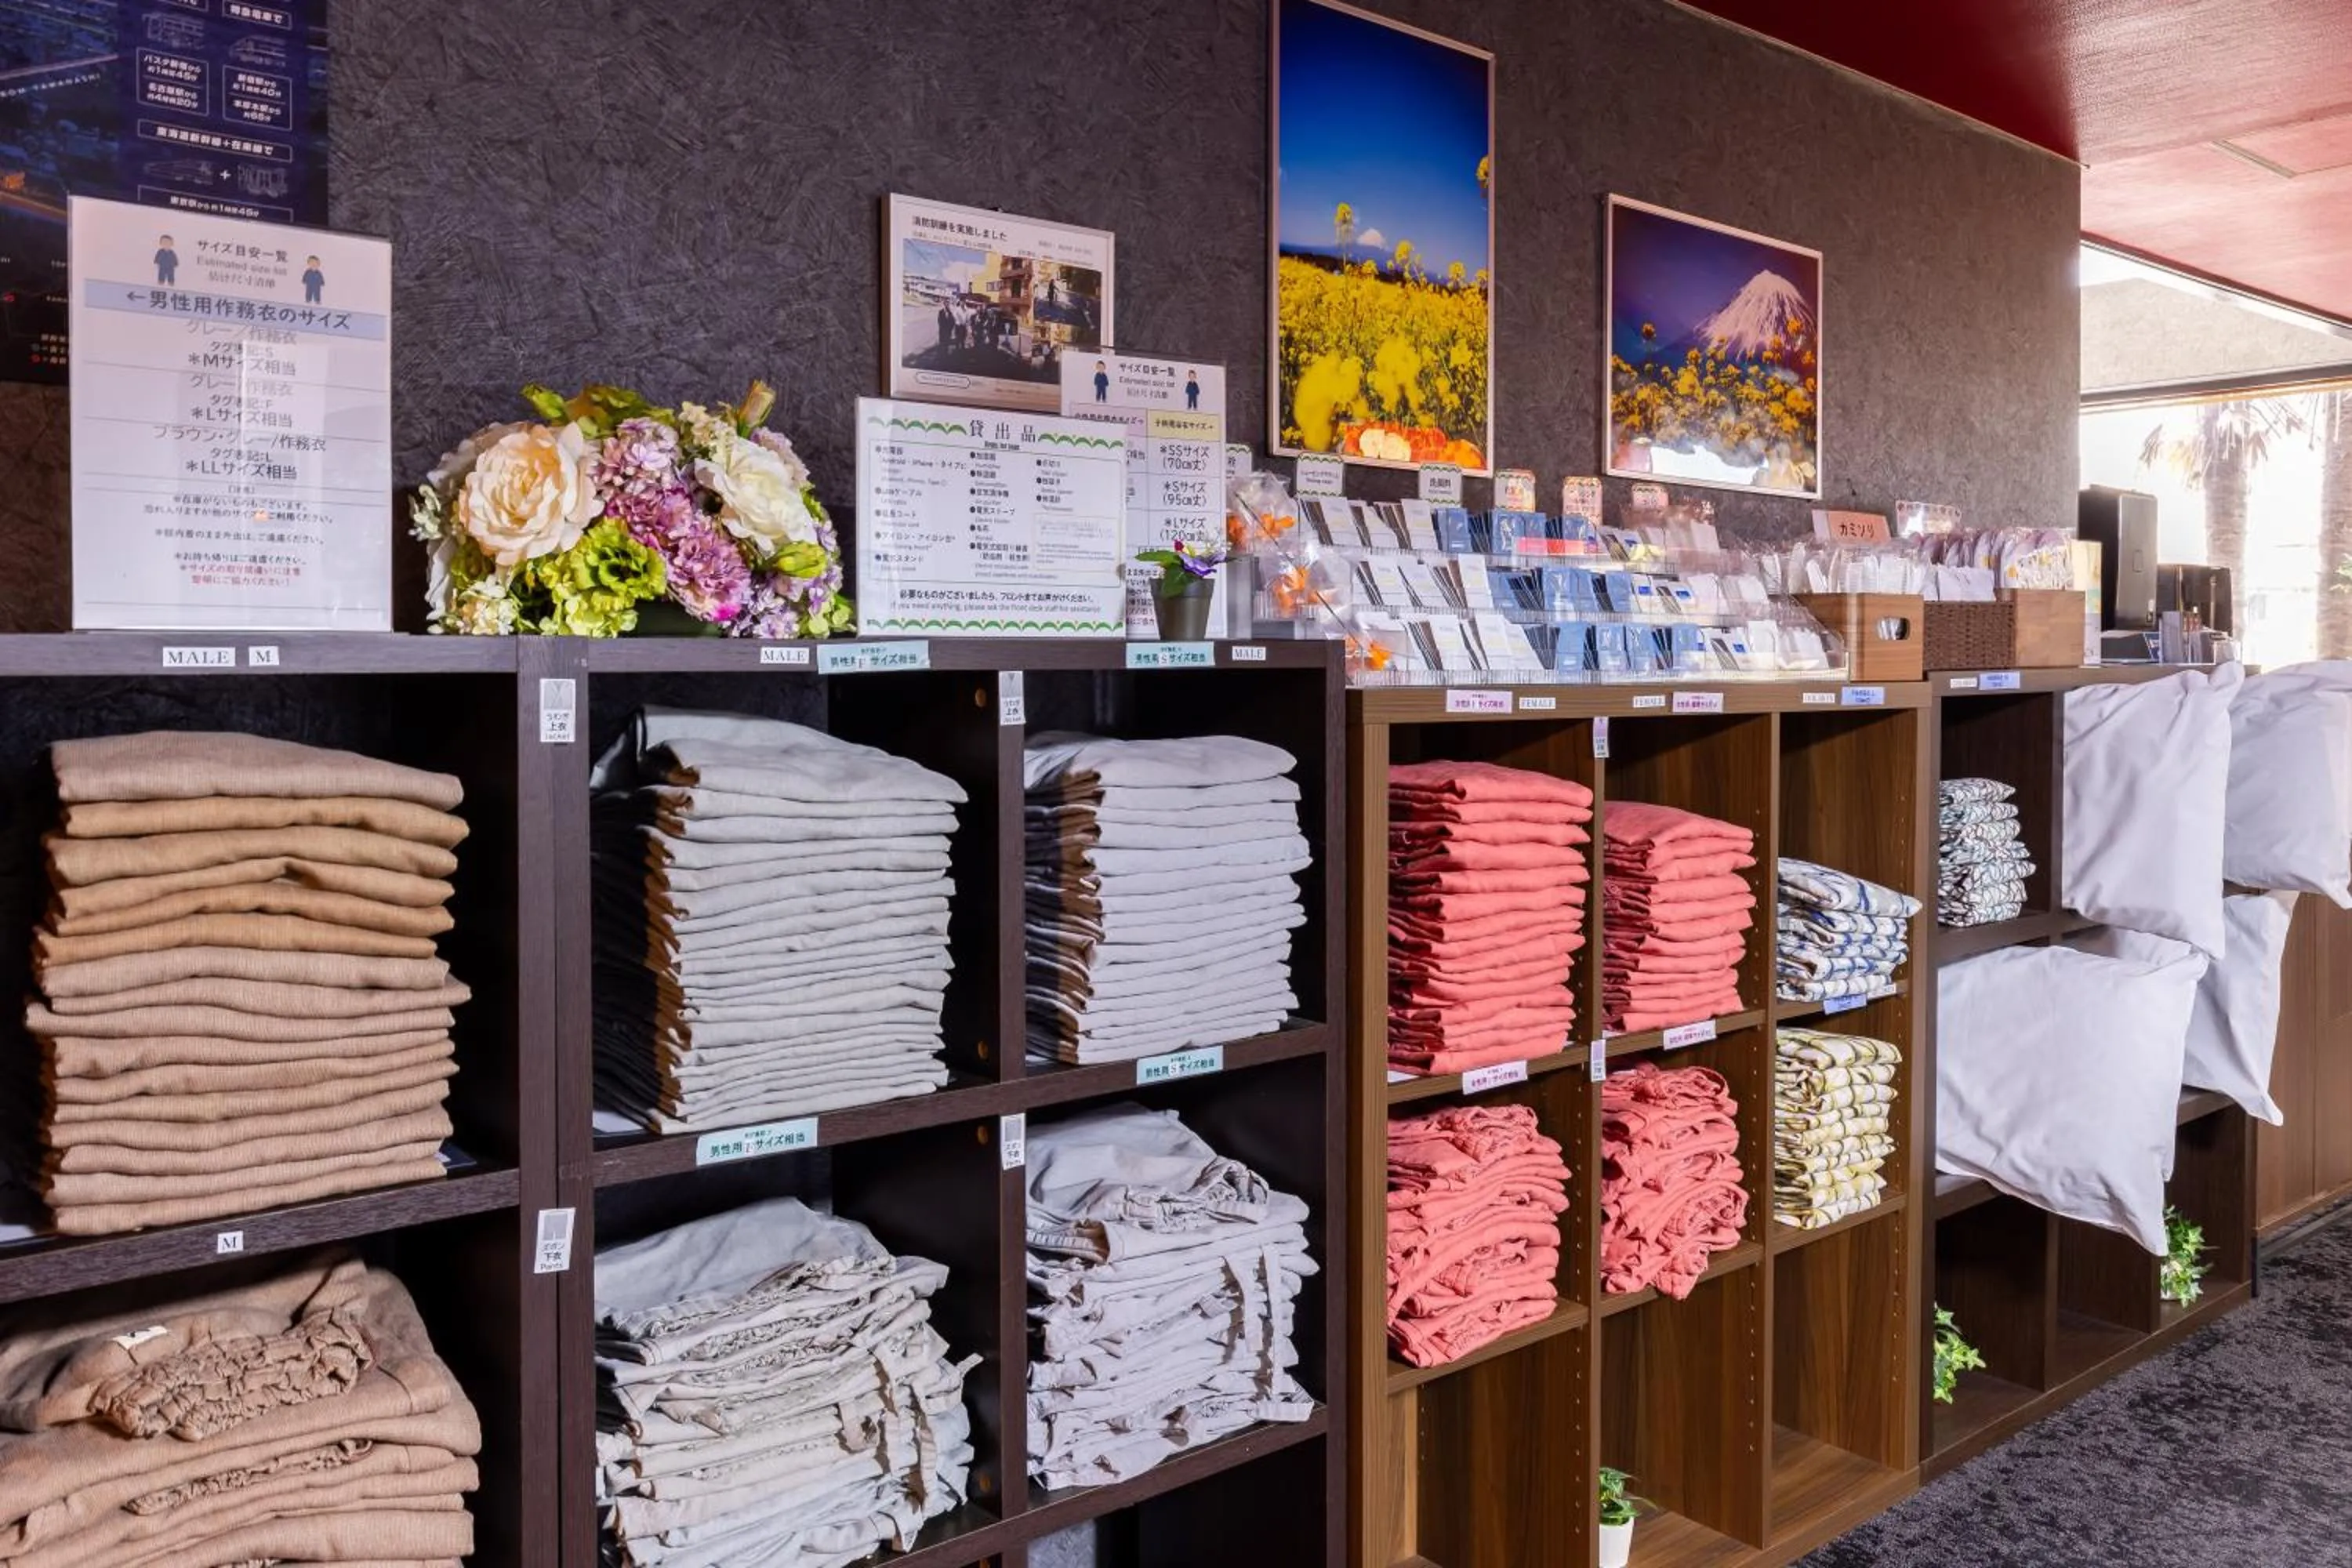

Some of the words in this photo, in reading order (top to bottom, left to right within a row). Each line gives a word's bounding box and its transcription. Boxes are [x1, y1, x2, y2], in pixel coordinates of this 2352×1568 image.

[197, 240, 289, 263] サイズ目安一覧
[1119, 362, 1176, 378] サイズ目安一覧
[1838, 522, 1875, 539] カミソリ
[167, 651, 230, 665] MALE
[255, 650, 271, 663] M
[762, 650, 806, 662] MALE
[1234, 649, 1264, 659] MALE
[223, 1237, 238, 1250] M
